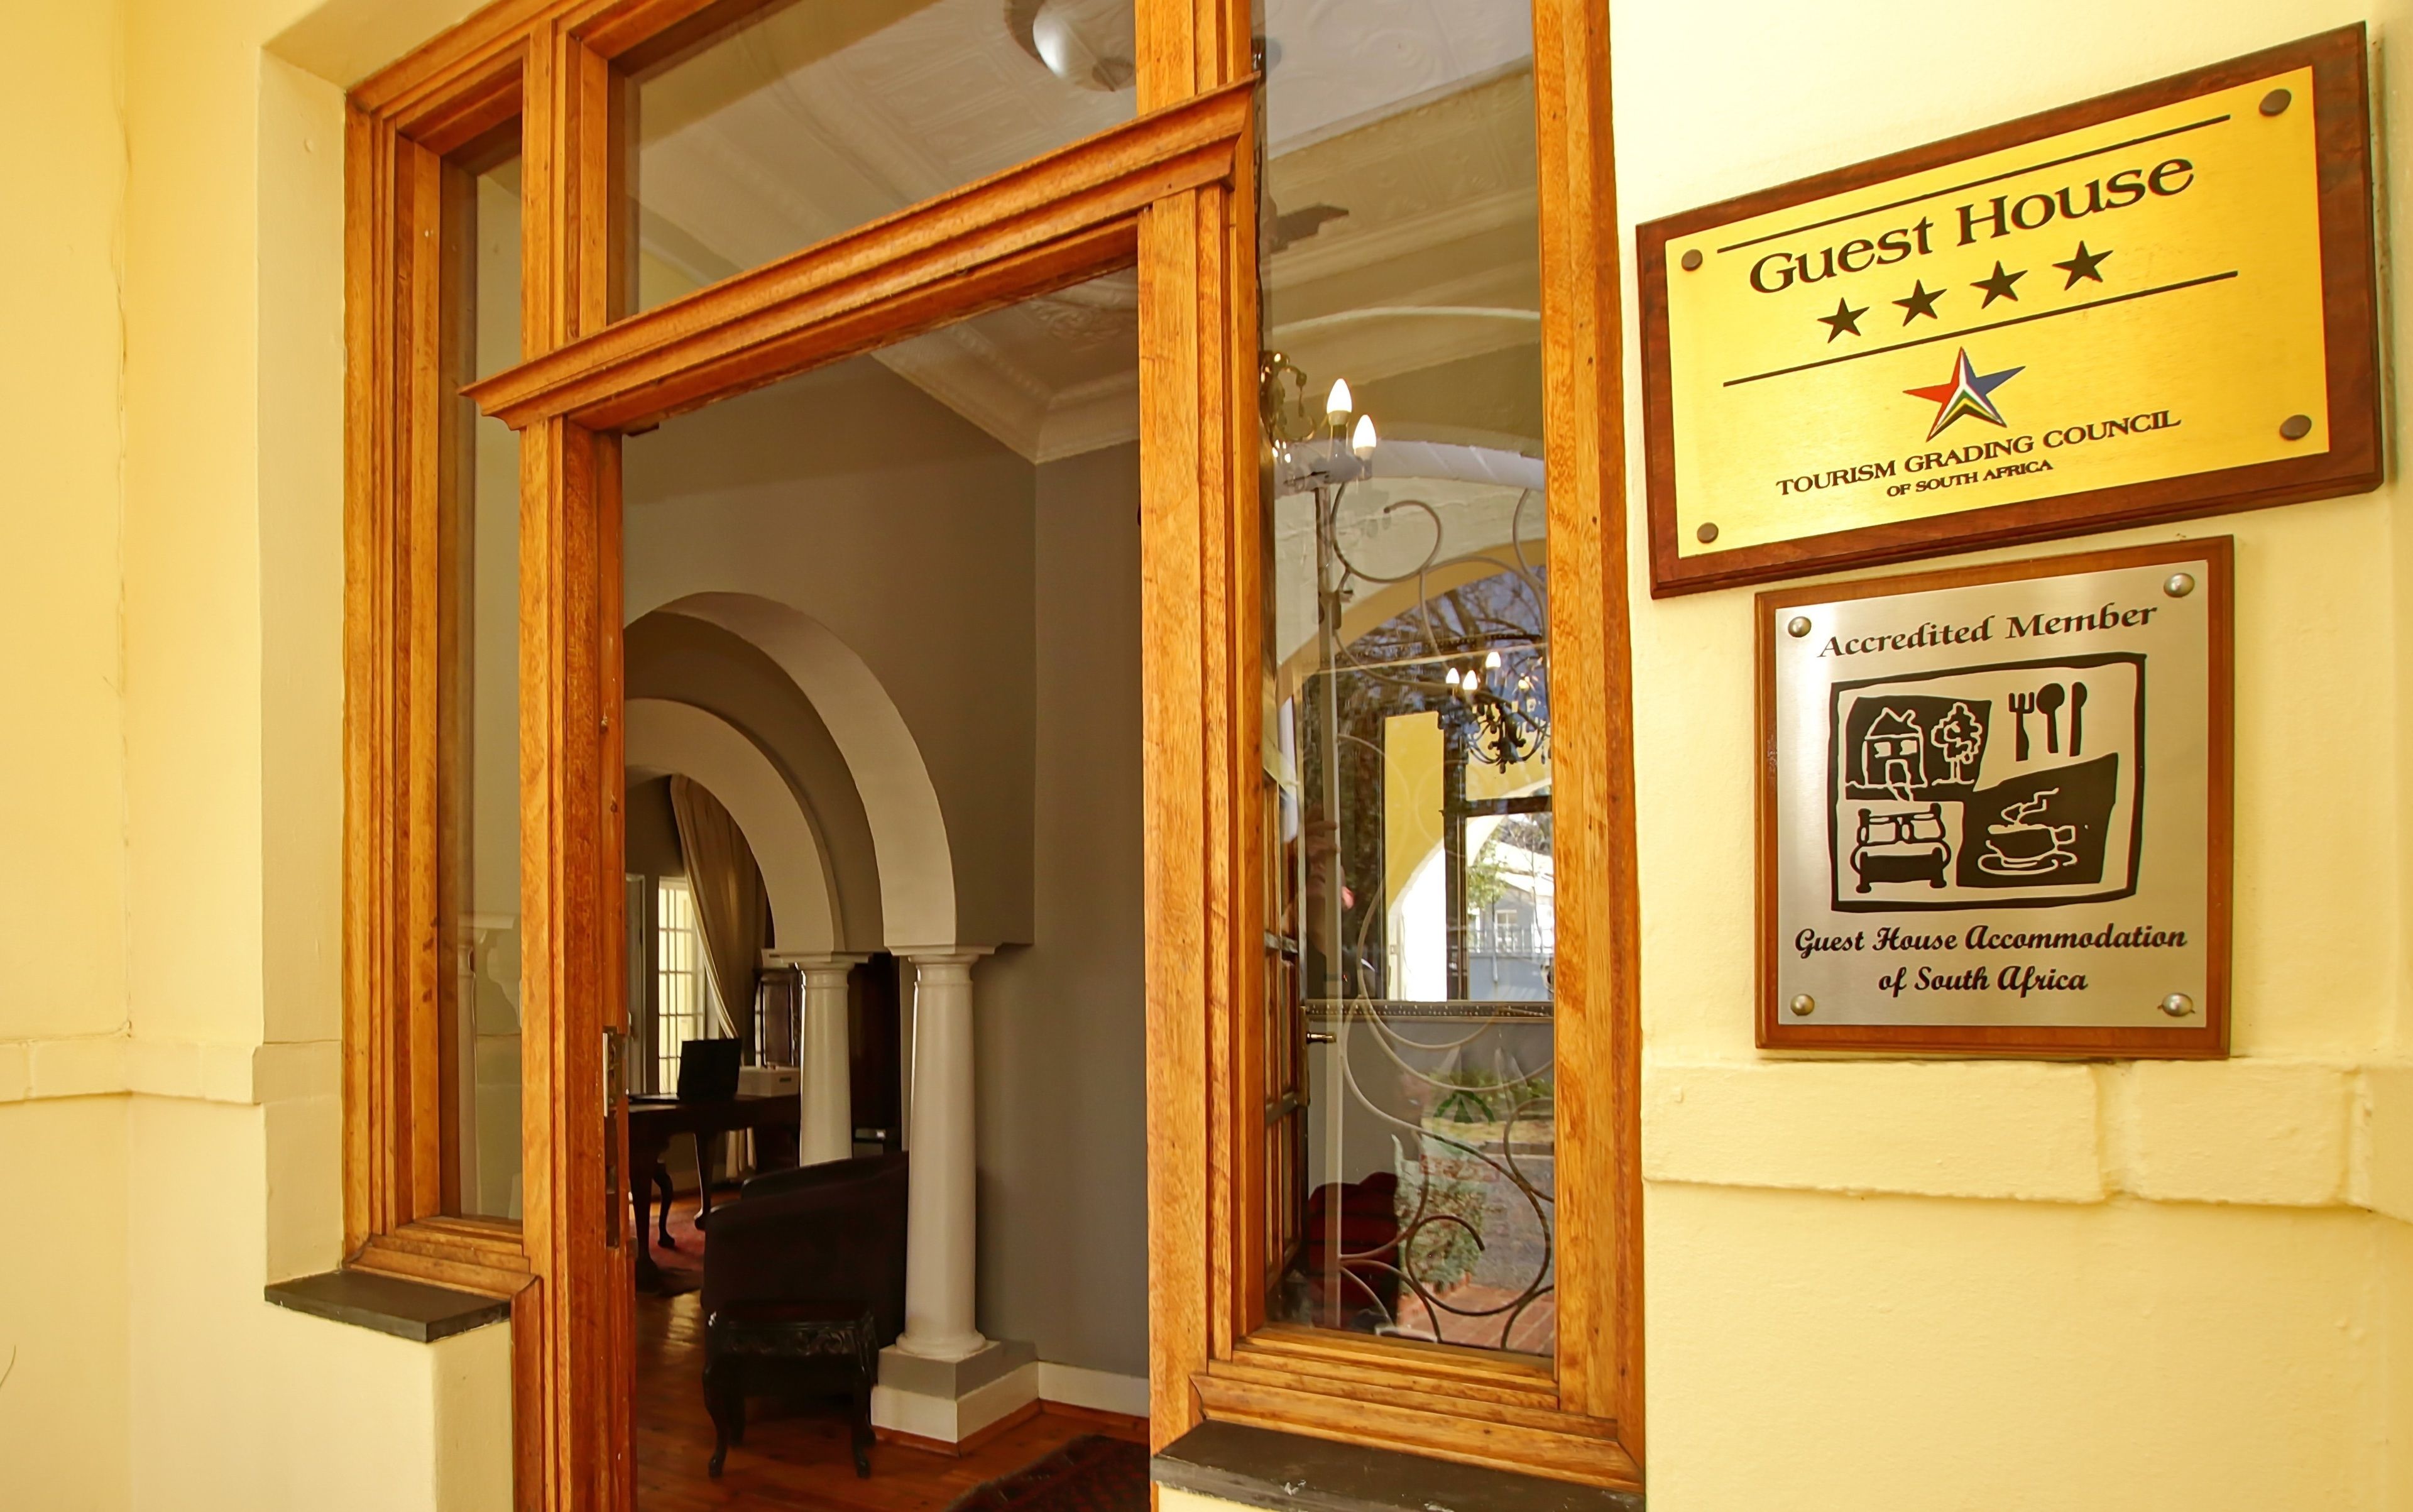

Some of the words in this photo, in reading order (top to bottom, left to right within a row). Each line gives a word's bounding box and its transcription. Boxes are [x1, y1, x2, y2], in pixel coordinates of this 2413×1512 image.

[1750, 217, 1934, 293] Guest
[1956, 158, 2194, 246] House
[1776, 459, 1896, 495] TOURISM
[1903, 436, 2035, 473] GRADING
[2043, 410, 2181, 447] COUNCIL
[1886, 483, 1912, 498] OF
[1915, 471, 1979, 493] SOUTH
[1983, 460, 2054, 481] AFRICA
[1817, 615, 1995, 657] Accredited
[2005, 601, 2158, 640] Member
[1794, 928, 1865, 959] Guest
[1871, 926, 1959, 951] House
[1965, 923, 2187, 950] Accommodation
[1878, 967, 1908, 998] of
[1913, 965, 1991, 991] South
[1996, 965, 2089, 999] Africa
